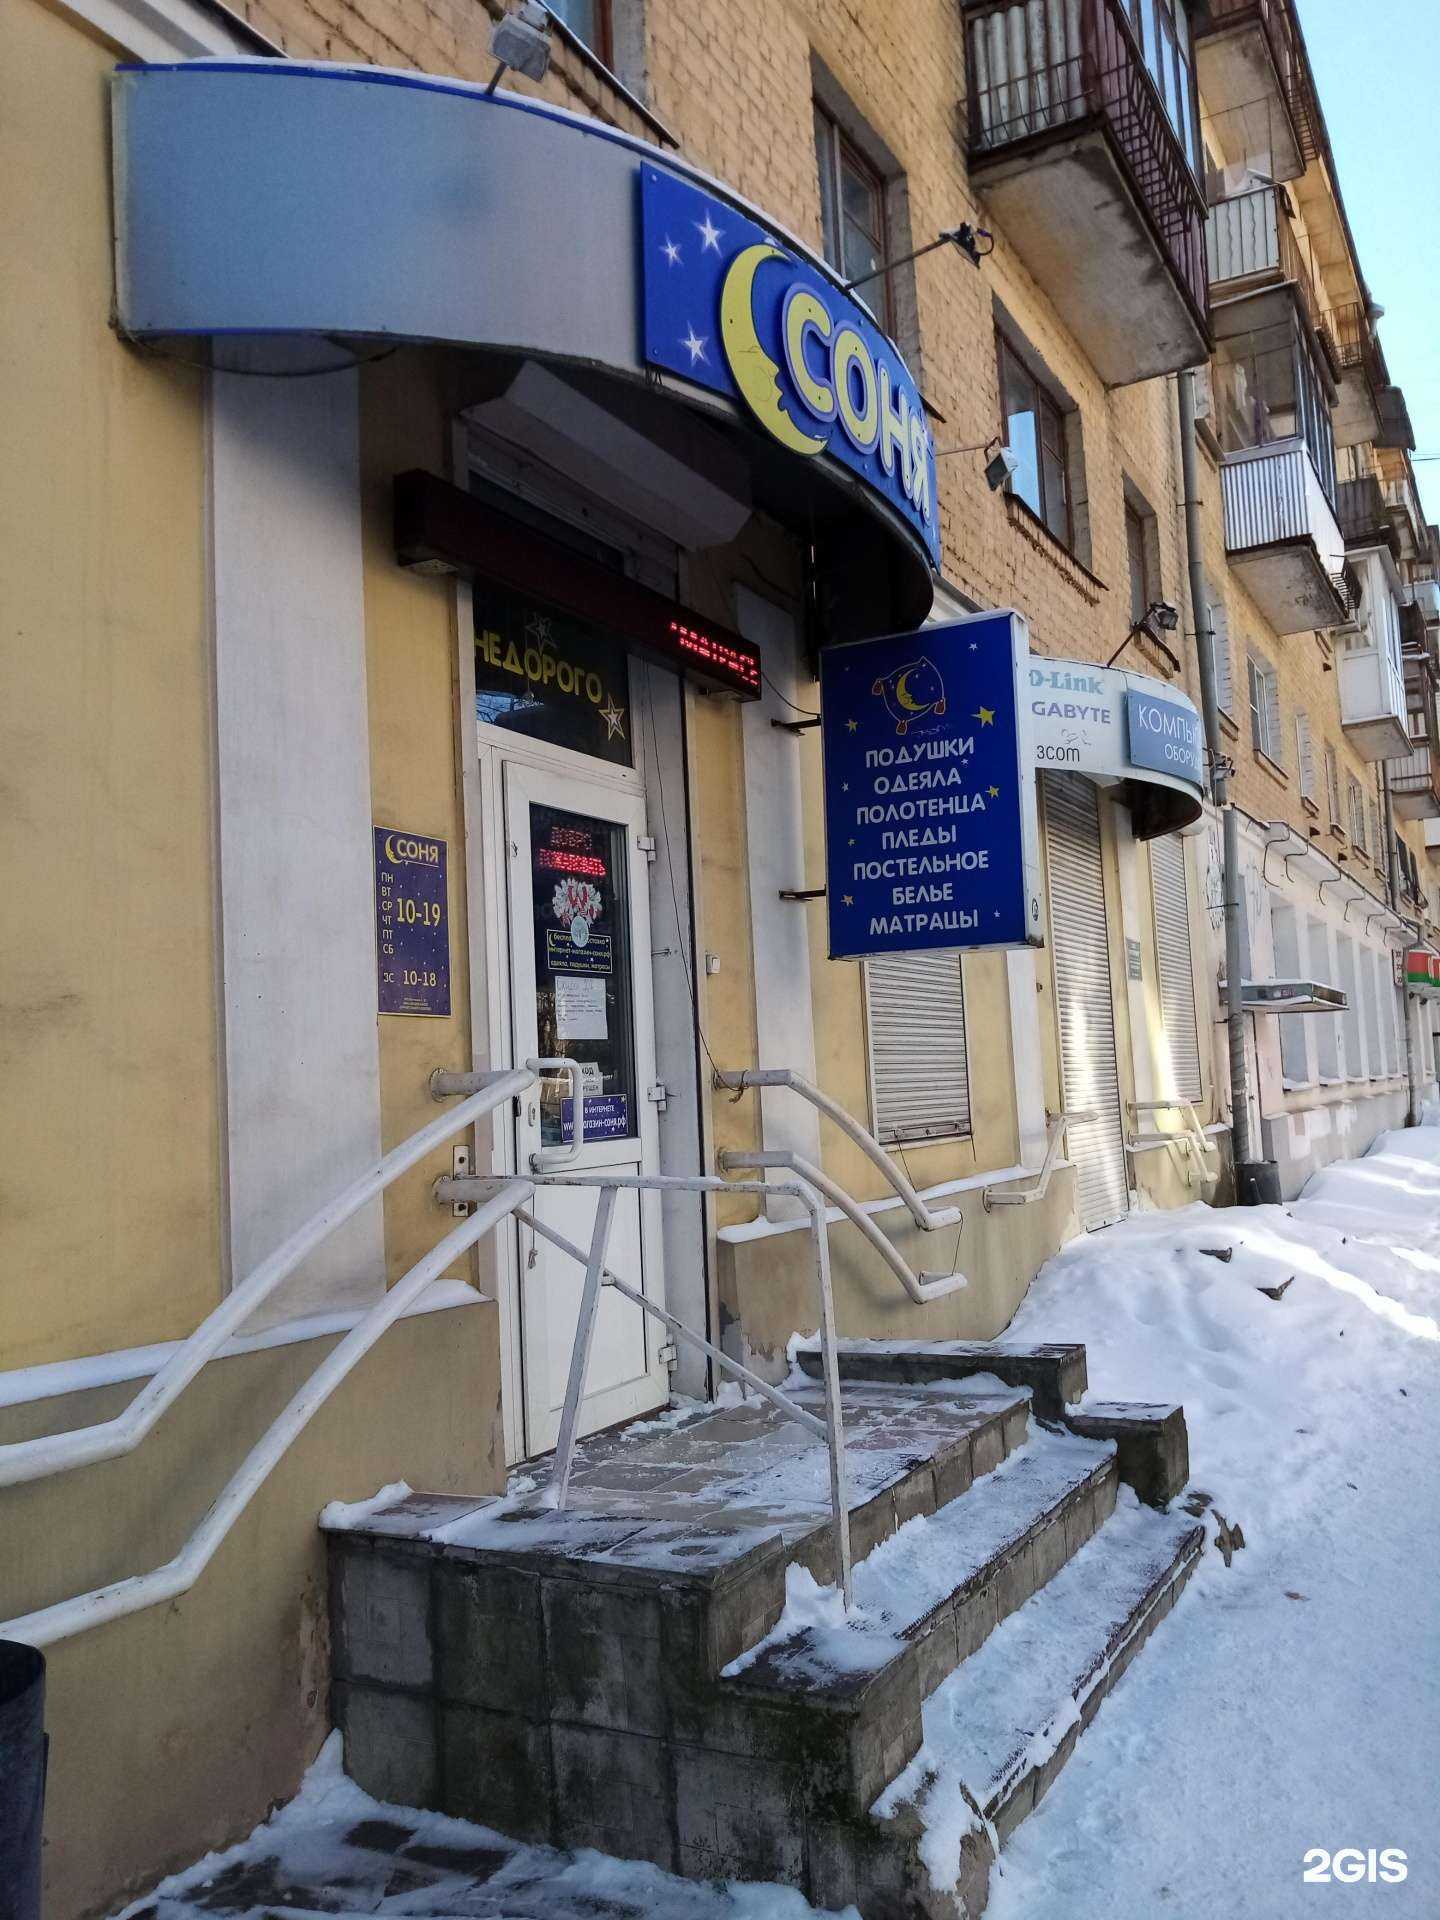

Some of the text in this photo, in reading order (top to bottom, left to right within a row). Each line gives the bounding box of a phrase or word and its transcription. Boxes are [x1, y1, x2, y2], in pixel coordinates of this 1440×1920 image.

[783, 285, 933, 524] СОНЯ
[1029, 669, 1104, 695] D-Link
[866, 736, 974, 768] ПОДУШКИ
[874, 767, 961, 795] ОДЕЯЛА
[856, 793, 986, 825] ПОЛОТЕНЦА
[882, 825, 956, 850] ПЛЕДЫ
[397, 839, 439, 863] СОНЯ
[381, 872, 393, 883] ПН
[853, 850, 989, 881] ПОСТЕЛЬНОЕ
[381, 886, 391, 897] ВТ
[892, 882, 953, 905] БЕЛЬЕ
[382, 898, 441, 927] СР 10-19
[382, 915, 392, 925] ЧТ
[869, 909, 978, 936] МАТРАЦЫ
[382, 930, 393, 940] ПТ
[383, 943, 394, 954] СБ
[403, 970, 436, 987] 10-18
